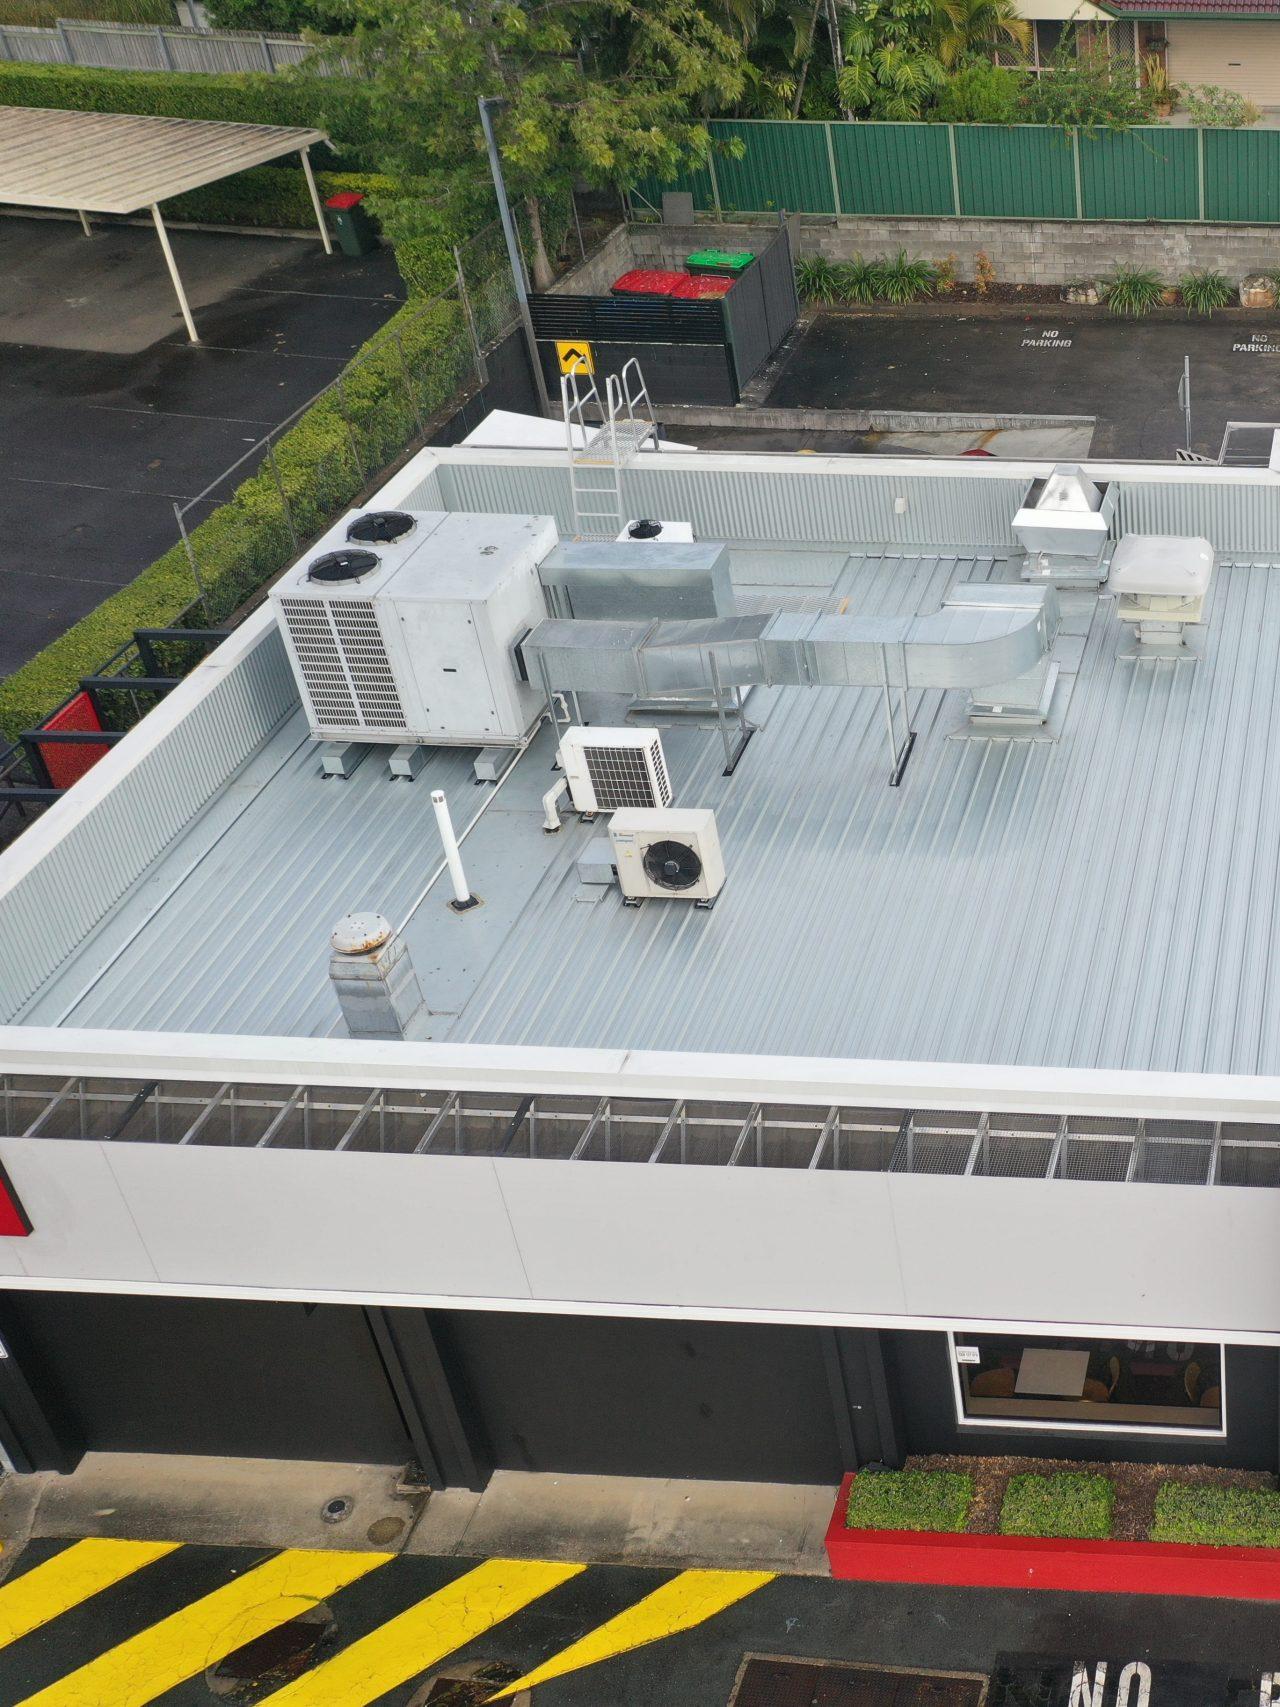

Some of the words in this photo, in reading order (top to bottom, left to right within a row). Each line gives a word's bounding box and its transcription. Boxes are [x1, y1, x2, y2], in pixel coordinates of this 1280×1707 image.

[1042, 330, 1059, 338] NO
[1251, 334, 1268, 342] NO
[1021, 339, 1072, 347] PARKING
[1068, 1660, 1152, 1707] NO
